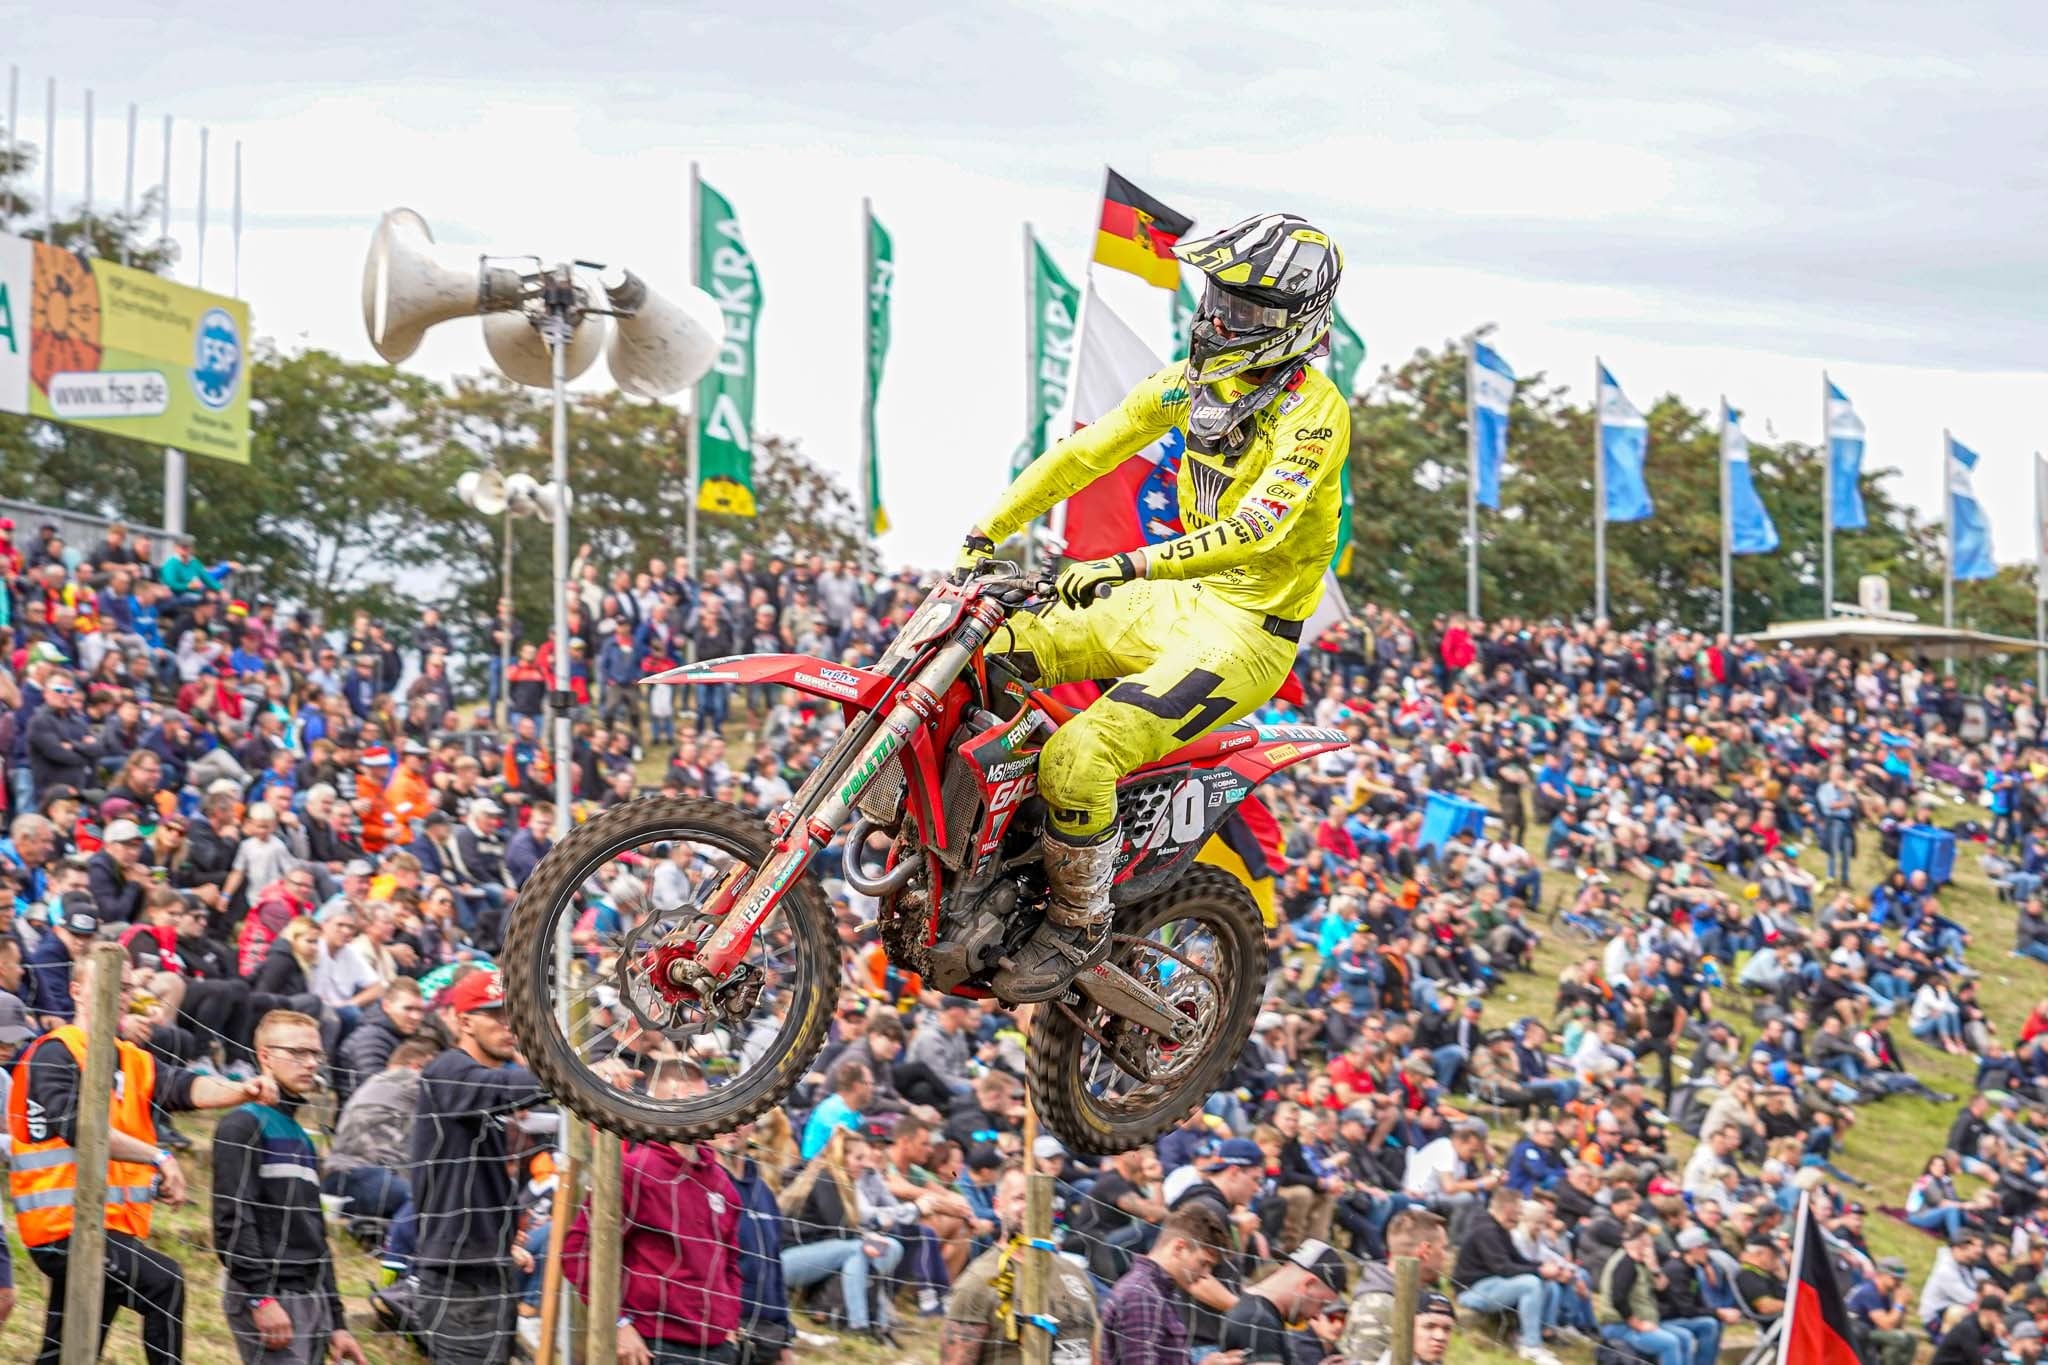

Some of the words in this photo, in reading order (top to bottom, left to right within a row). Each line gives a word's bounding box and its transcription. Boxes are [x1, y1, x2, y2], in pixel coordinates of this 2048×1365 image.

[712, 218, 755, 378] DEKRA
[55, 378, 164, 411] www.fsp.de
[743, 886, 771, 921] FEAB
